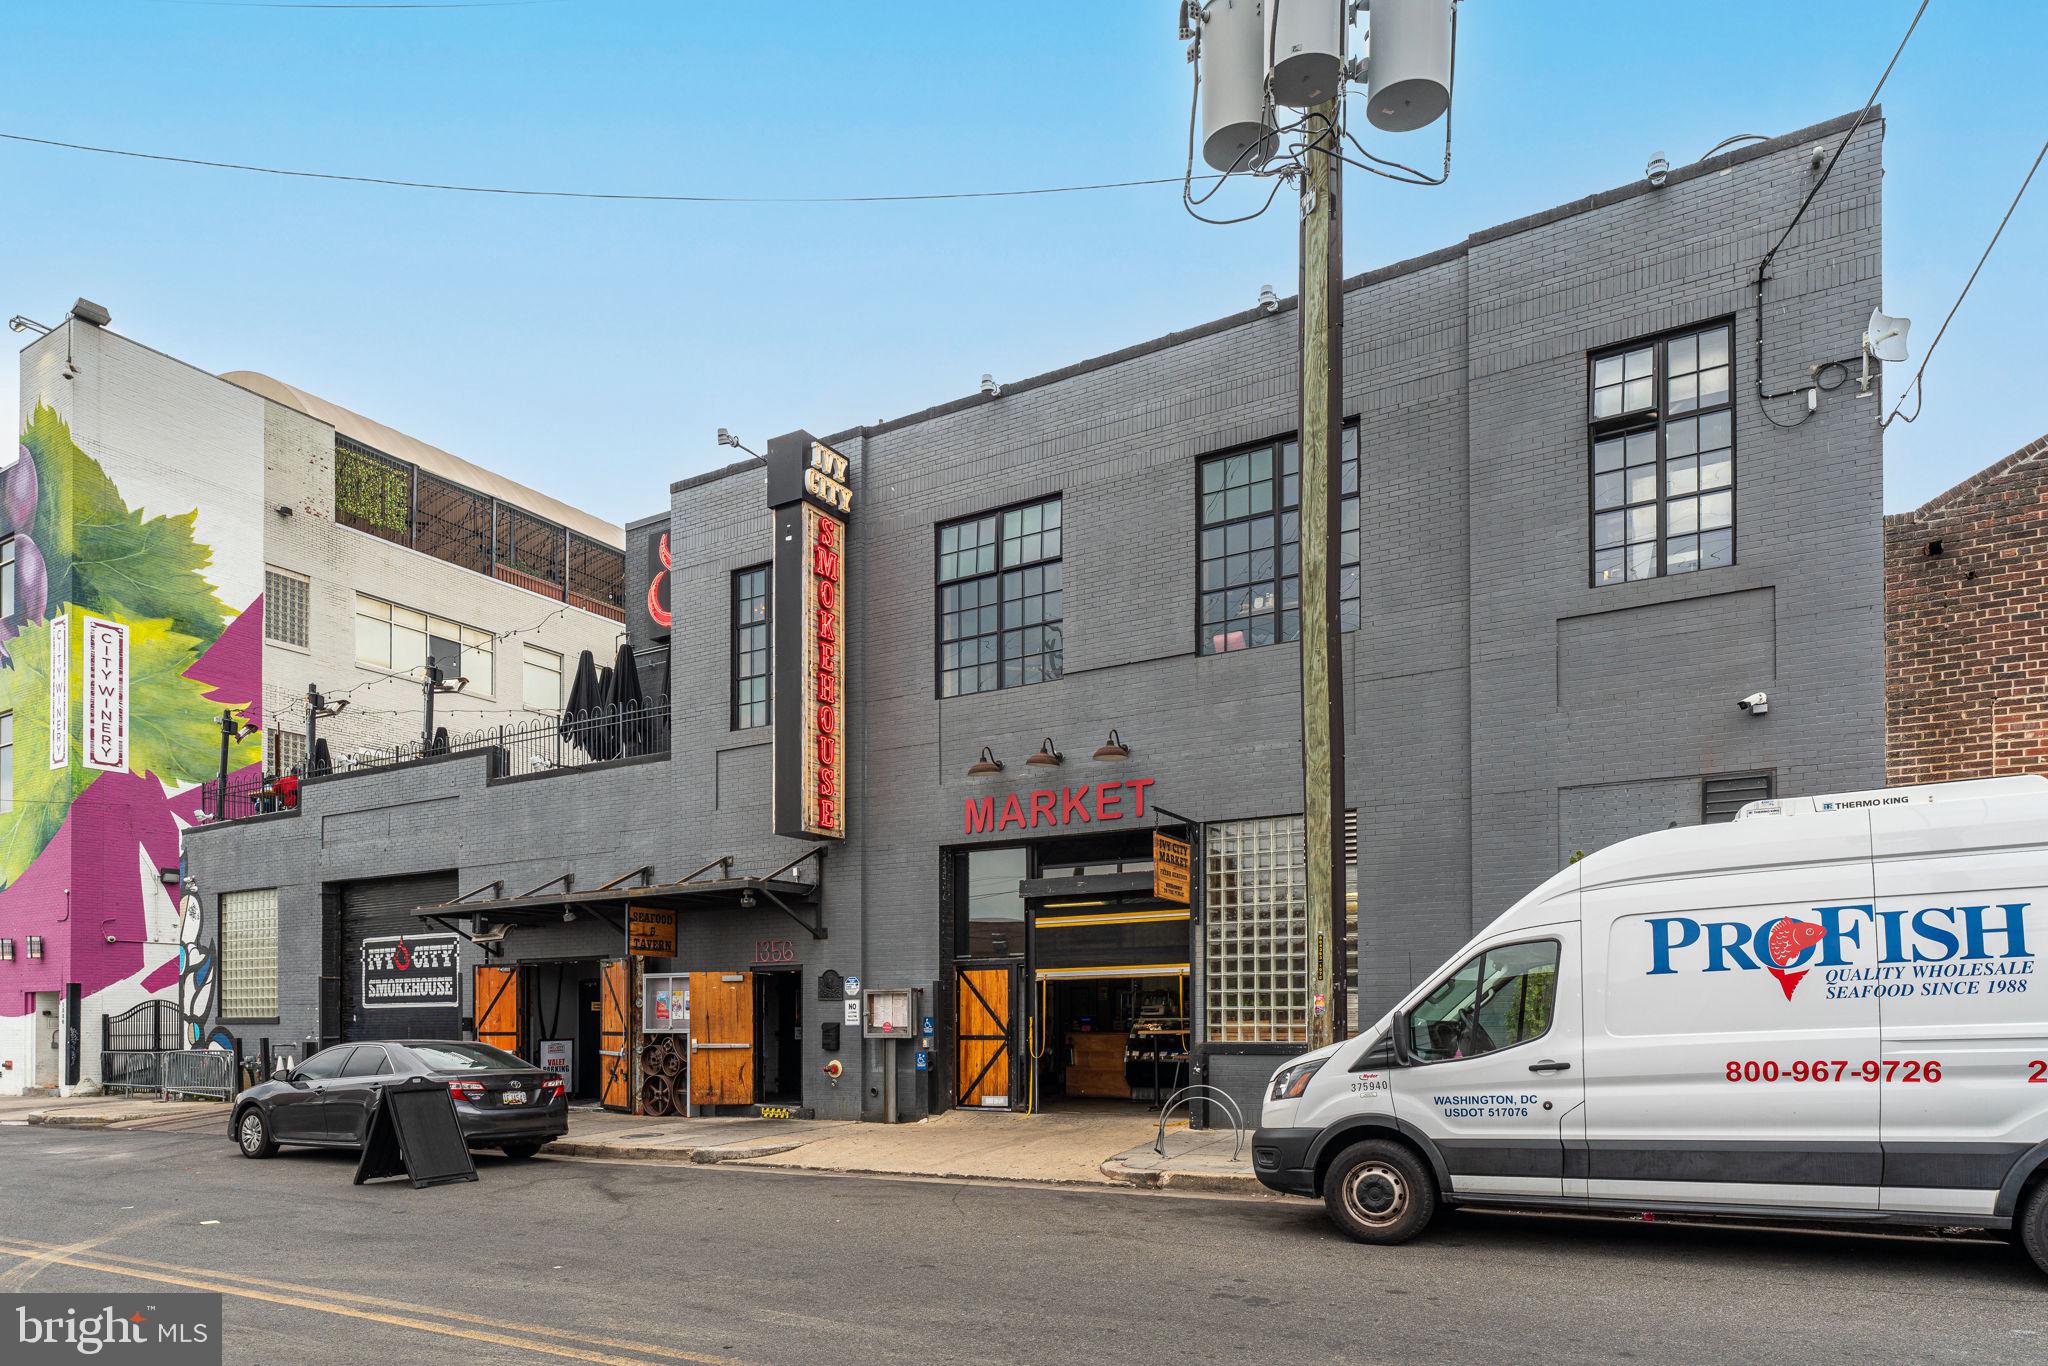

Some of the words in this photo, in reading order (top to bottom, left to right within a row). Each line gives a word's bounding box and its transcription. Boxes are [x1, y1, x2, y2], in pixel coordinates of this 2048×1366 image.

[811, 441, 848, 482] IVY
[804, 468, 853, 513] CITY
[101, 633, 112, 680] CITY
[815, 515, 838, 829] SMOKEHOUSE
[55, 683, 63, 754] WINERY
[98, 684, 115, 757] WINERY
[964, 777, 1155, 835] MARKET
[1835, 798, 1881, 810] THERMO
[1882, 796, 1909, 805] KING
[1159, 838, 1173, 852] IVY
[1172, 843, 1188, 857] CITY
[1159, 851, 1188, 868] MARKET
[633, 911, 673, 925] SEAFOOD
[634, 938, 672, 951] TAVERN
[755, 939, 794, 962] 1356
[367, 947, 397, 970] IVY
[411, 944, 454, 969] CITY
[1825, 966, 1905, 985] QUALITY
[1913, 960, 2035, 979] WHOLESALE
[368, 976, 453, 997] SMOKEHOUSE
[1825, 982, 1915, 1000] SEAFOOD
[1920, 980, 1980, 997] SINCE
[1987, 978, 2028, 994] 1988
[547, 1058, 565, 1066] VALET
[1726, 1060, 1942, 1083] 800-967-9726
[1351, 1080, 1388, 1093] 375940
[1433, 1095, 1517, 1106] WASHINGTON,
[1520, 1095, 1538, 1104] DC
[1444, 1108, 1485, 1117] USDOT
[1488, 1107, 1528, 1117] 517076
